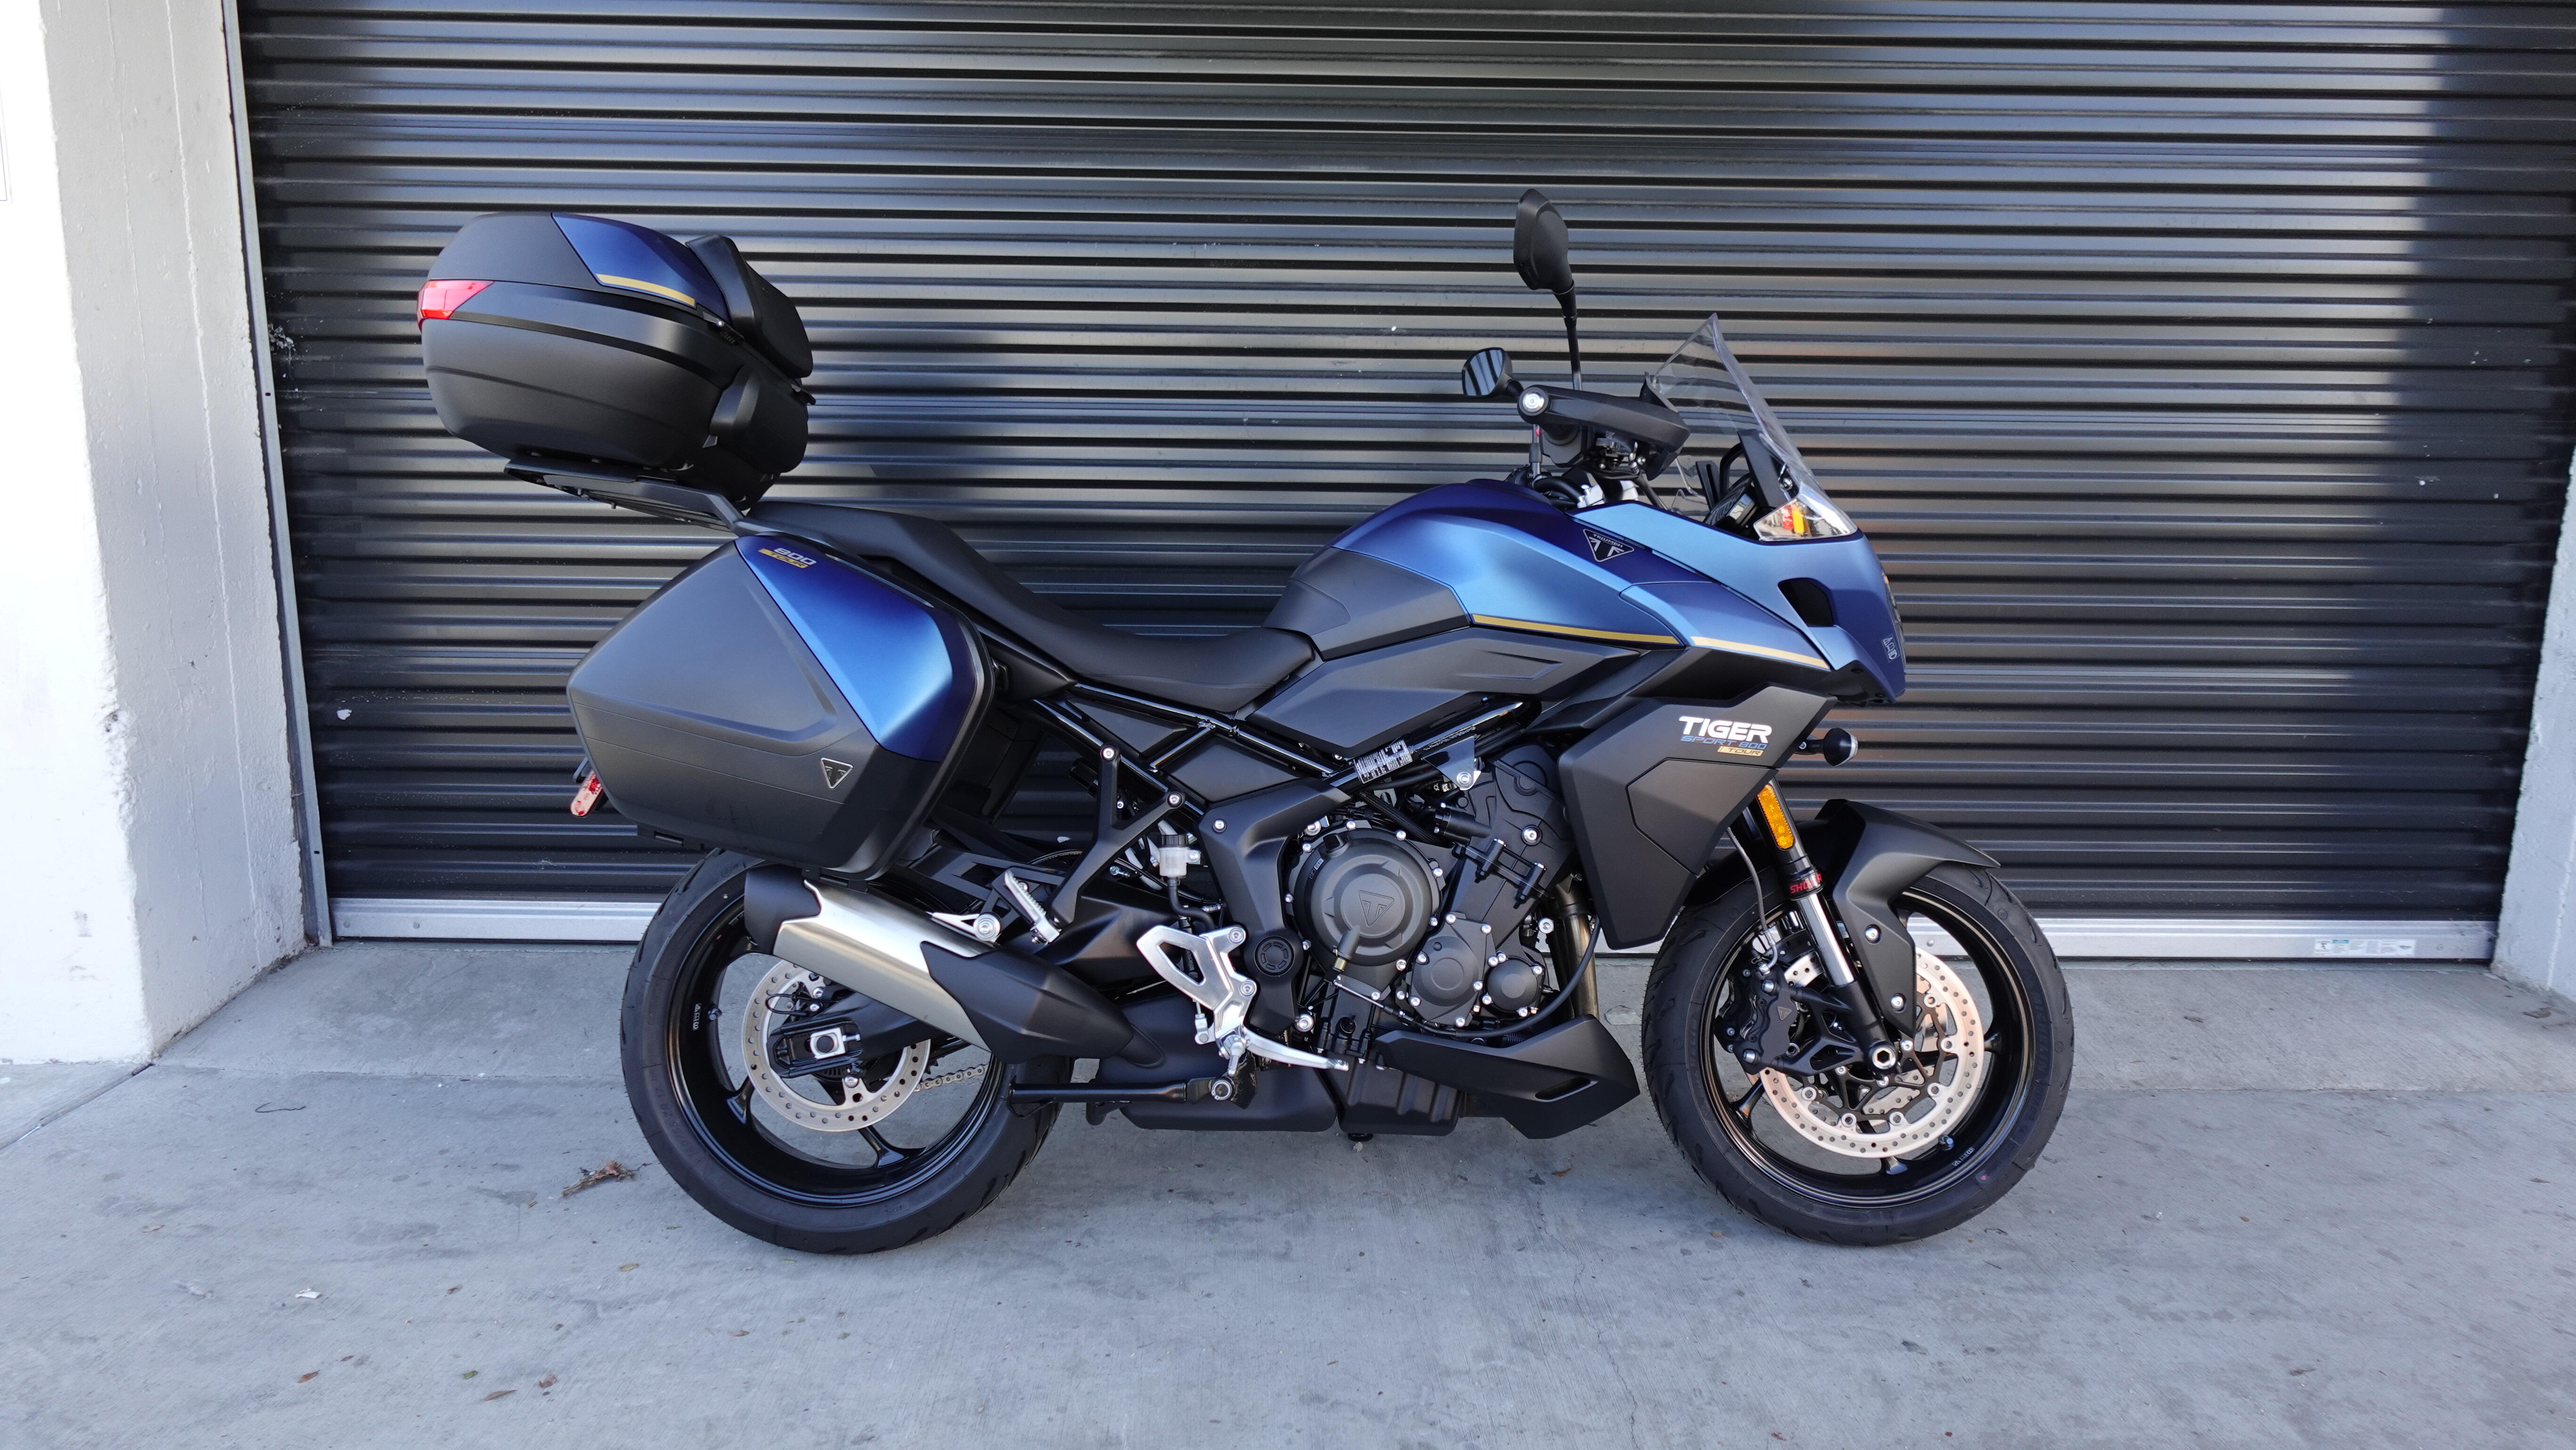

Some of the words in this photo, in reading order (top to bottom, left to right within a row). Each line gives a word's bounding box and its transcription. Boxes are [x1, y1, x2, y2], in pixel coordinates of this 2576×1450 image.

[1593, 533, 1623, 548] TRIUMPH
[771, 552, 806, 566] TOUR
[773, 547, 817, 566] 800
[1679, 716, 1772, 743] TIGER
[1680, 735, 1737, 746] SPORT
[1738, 741, 1769, 750] 800
